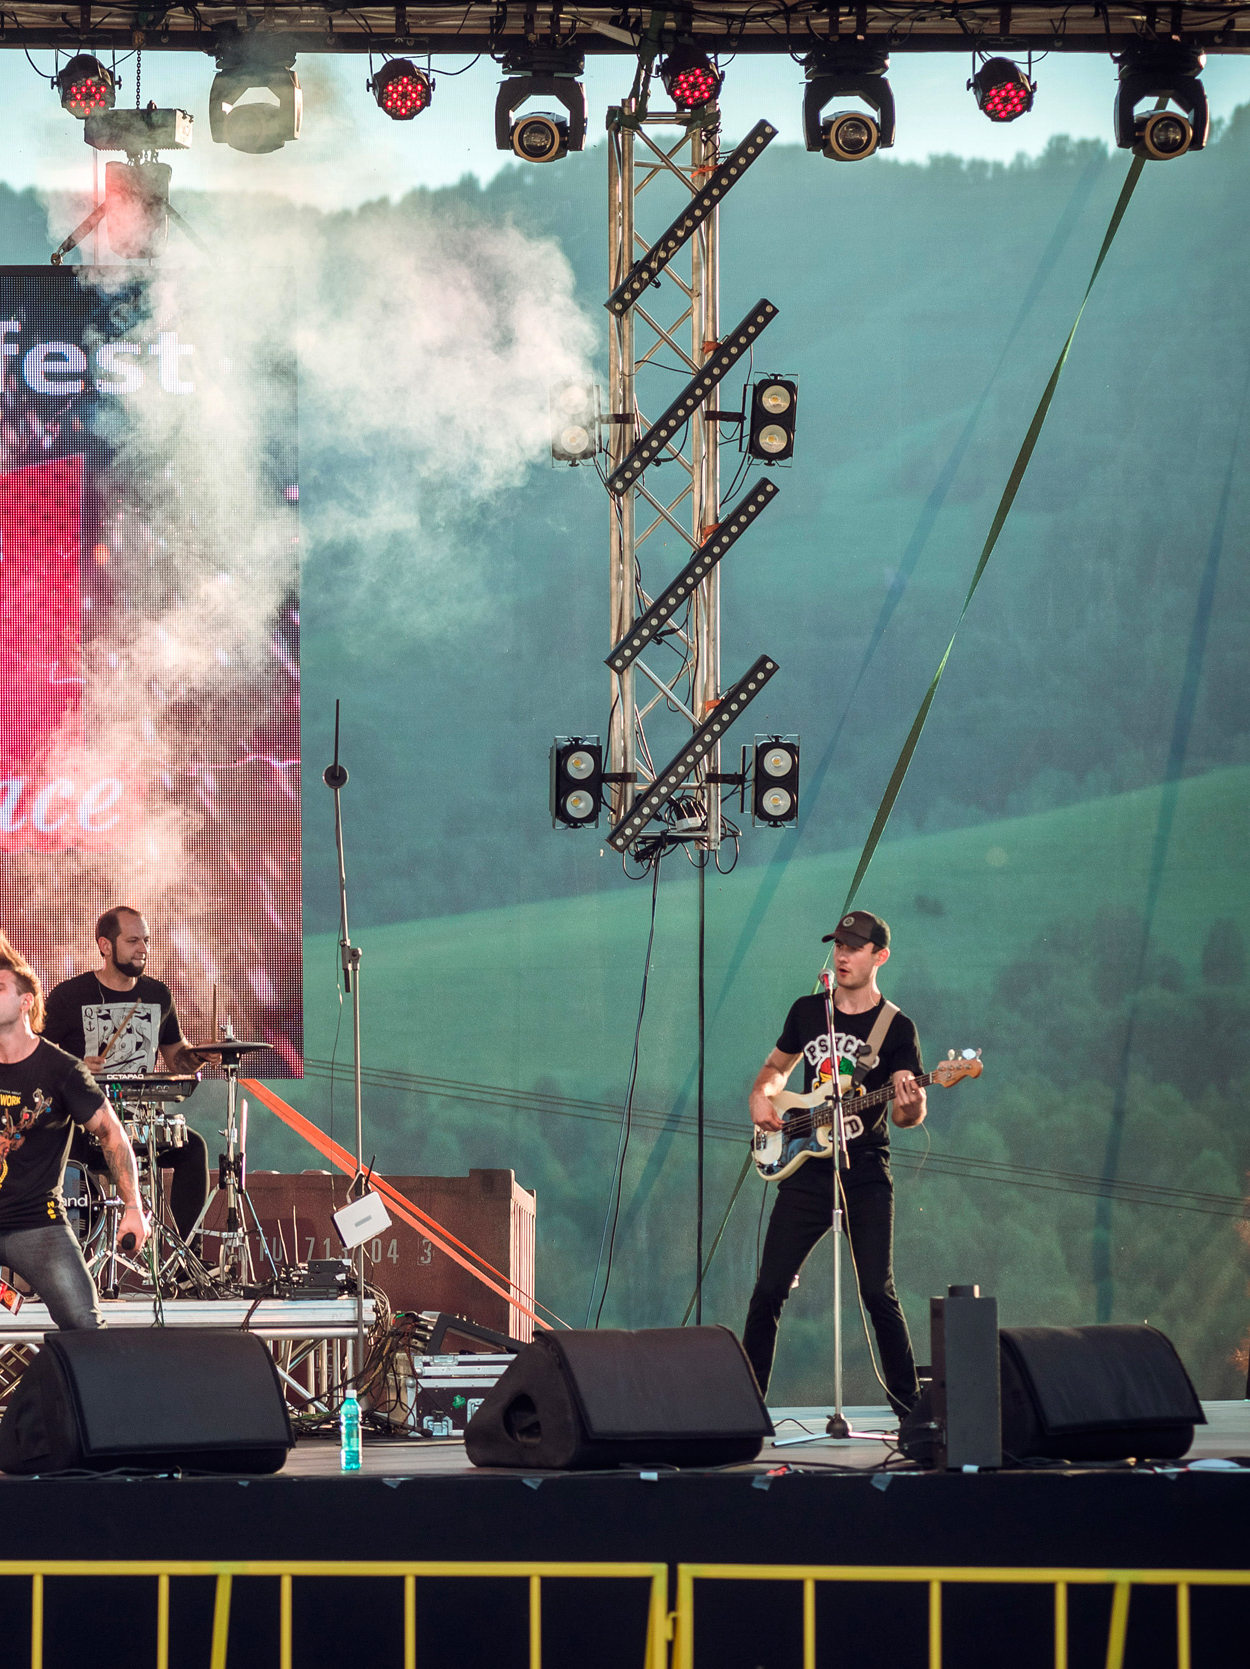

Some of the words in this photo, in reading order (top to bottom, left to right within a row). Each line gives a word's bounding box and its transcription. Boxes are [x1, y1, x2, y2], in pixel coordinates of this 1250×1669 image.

[84, 1008, 94, 1020] Q
[804, 1032, 880, 1067] PSYC
[0, 1093, 22, 1107] WORK
[64, 1194, 89, 1208] and
[419, 1238, 433, 1264] 3
